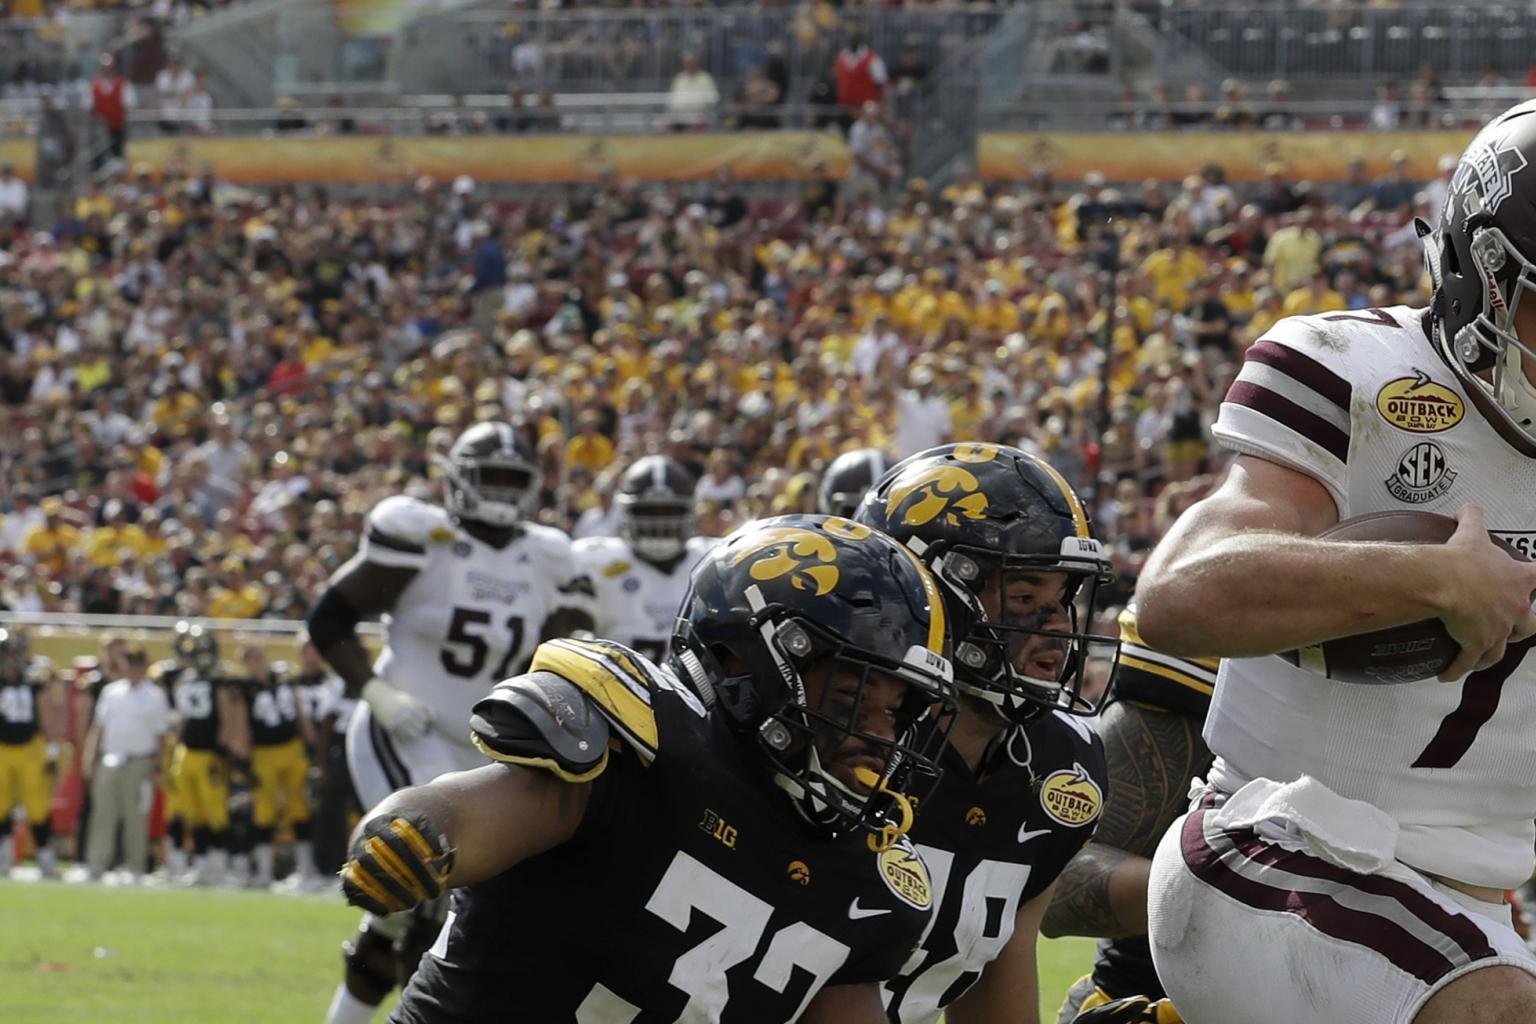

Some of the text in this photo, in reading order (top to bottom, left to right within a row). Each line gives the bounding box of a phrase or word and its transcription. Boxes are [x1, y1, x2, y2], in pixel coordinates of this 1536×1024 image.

[1388, 401, 1456, 418] OUTBACK
[1396, 415, 1449, 425] BOWL
[1400, 443, 1444, 487] SEC
[1393, 481, 1448, 503] GRADUATE
[440, 607, 524, 682] 51
[1047, 791, 1094, 815] OUTBACK
[886, 865, 927, 899] OUTBACK
